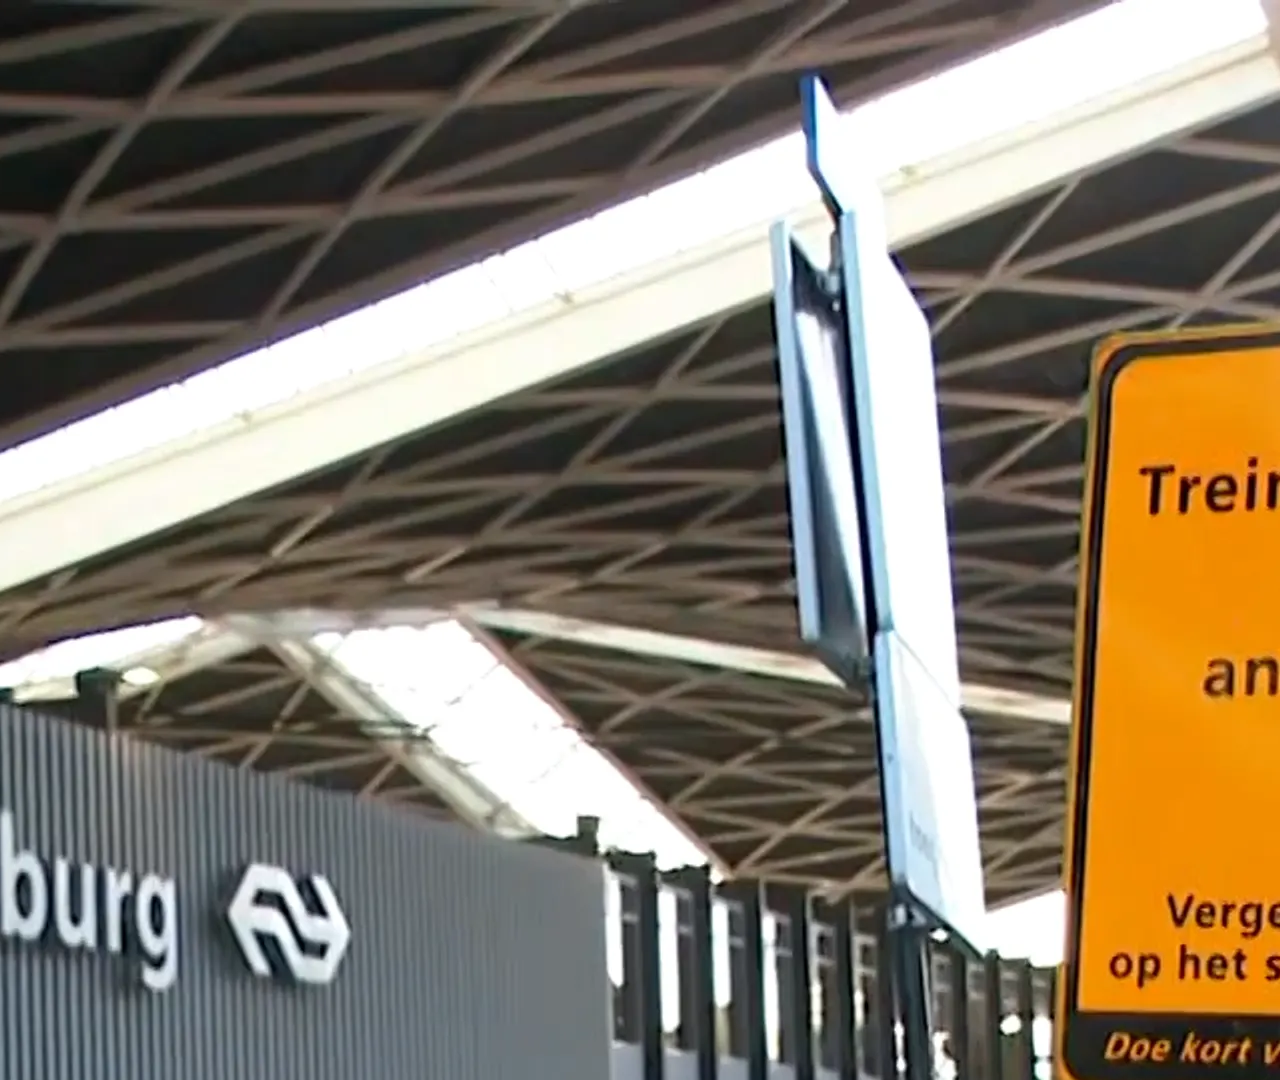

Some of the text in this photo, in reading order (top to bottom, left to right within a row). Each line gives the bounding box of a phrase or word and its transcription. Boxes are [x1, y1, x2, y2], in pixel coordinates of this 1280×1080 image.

[1109, 952, 1161, 989] op
[1178, 943, 1247, 981] het
[1105, 1032, 1171, 1062] Doe
[1180, 1032, 1252, 1063] kort
